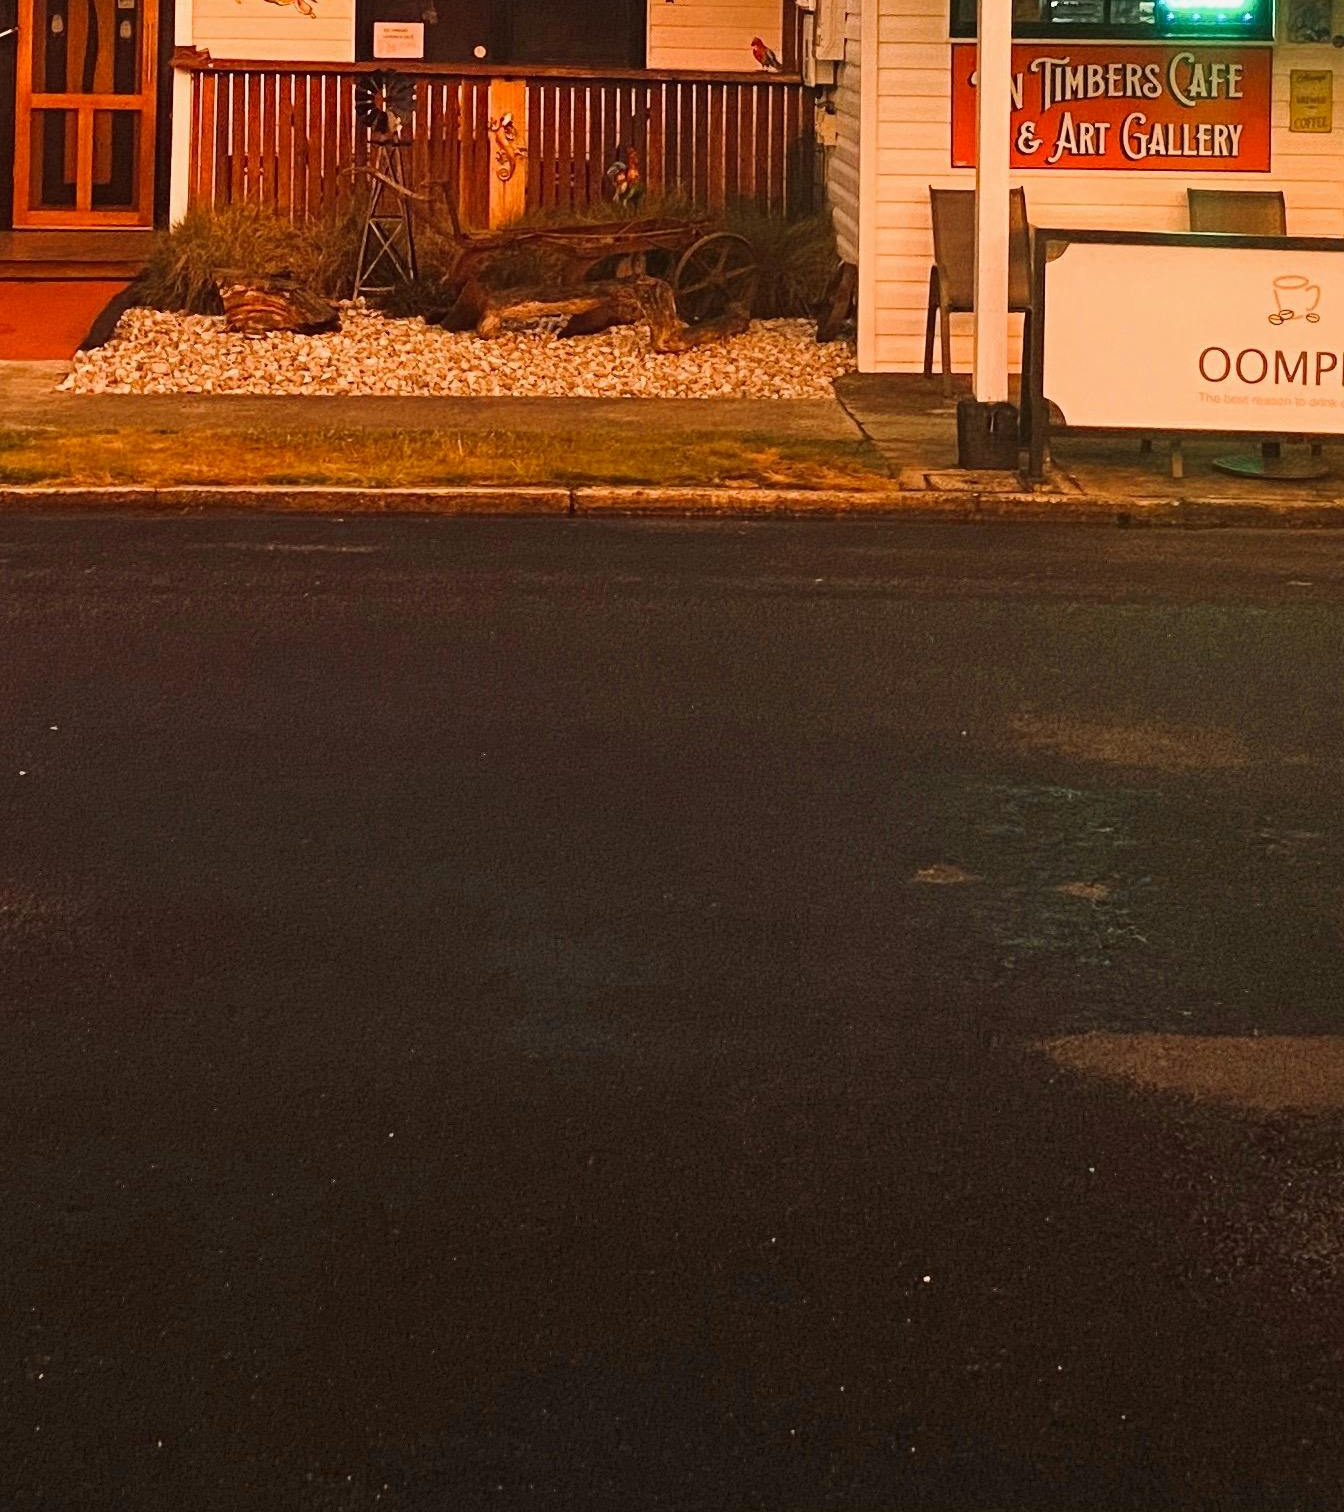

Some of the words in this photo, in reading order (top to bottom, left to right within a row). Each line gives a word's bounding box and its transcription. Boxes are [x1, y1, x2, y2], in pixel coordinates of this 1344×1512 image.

[1031, 56, 1163, 111] TIMBERS
[1169, 52, 1244, 107] CAFE
[1017, 121, 1042, 154] &
[1048, 112, 1111, 163] ART
[1122, 112, 1244, 160] GALLERY
[1199, 391, 1221, 404] The
[1223, 393, 1249, 405] best
[1295, 396, 1306, 407] to
